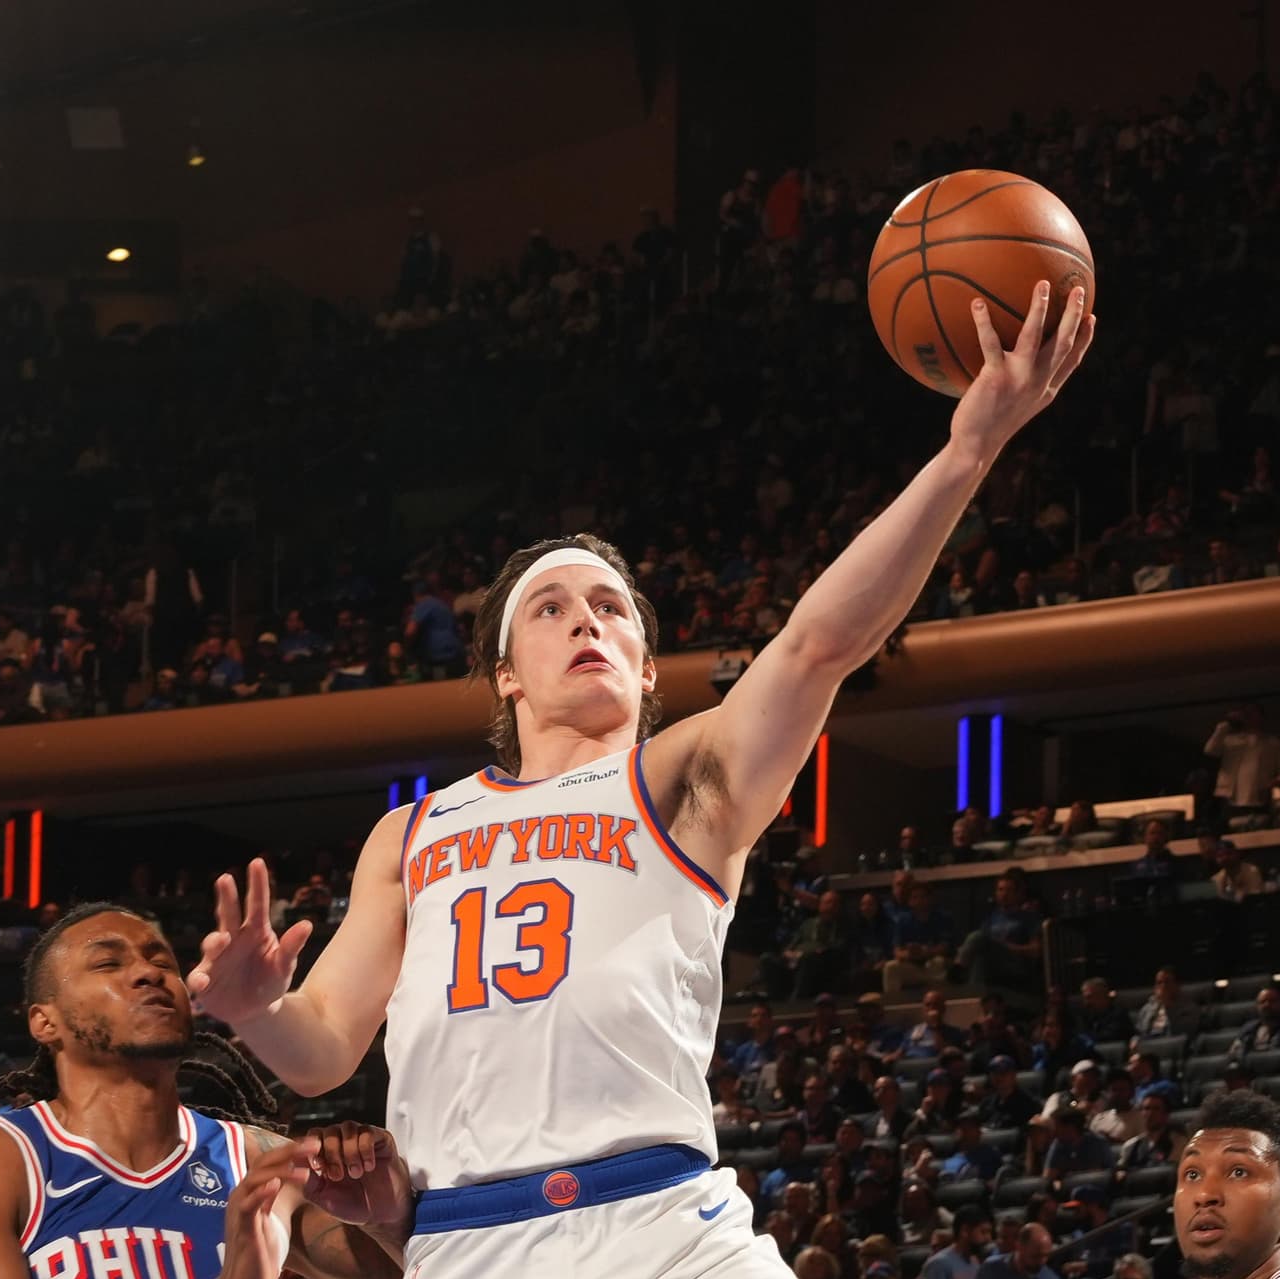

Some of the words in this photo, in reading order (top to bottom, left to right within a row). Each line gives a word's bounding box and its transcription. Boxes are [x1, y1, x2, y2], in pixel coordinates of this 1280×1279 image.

[584, 768, 619, 783] dhabi
[407, 823, 503, 906] NEW
[508, 813, 638, 875] YORK
[447, 877, 575, 1014] 13
